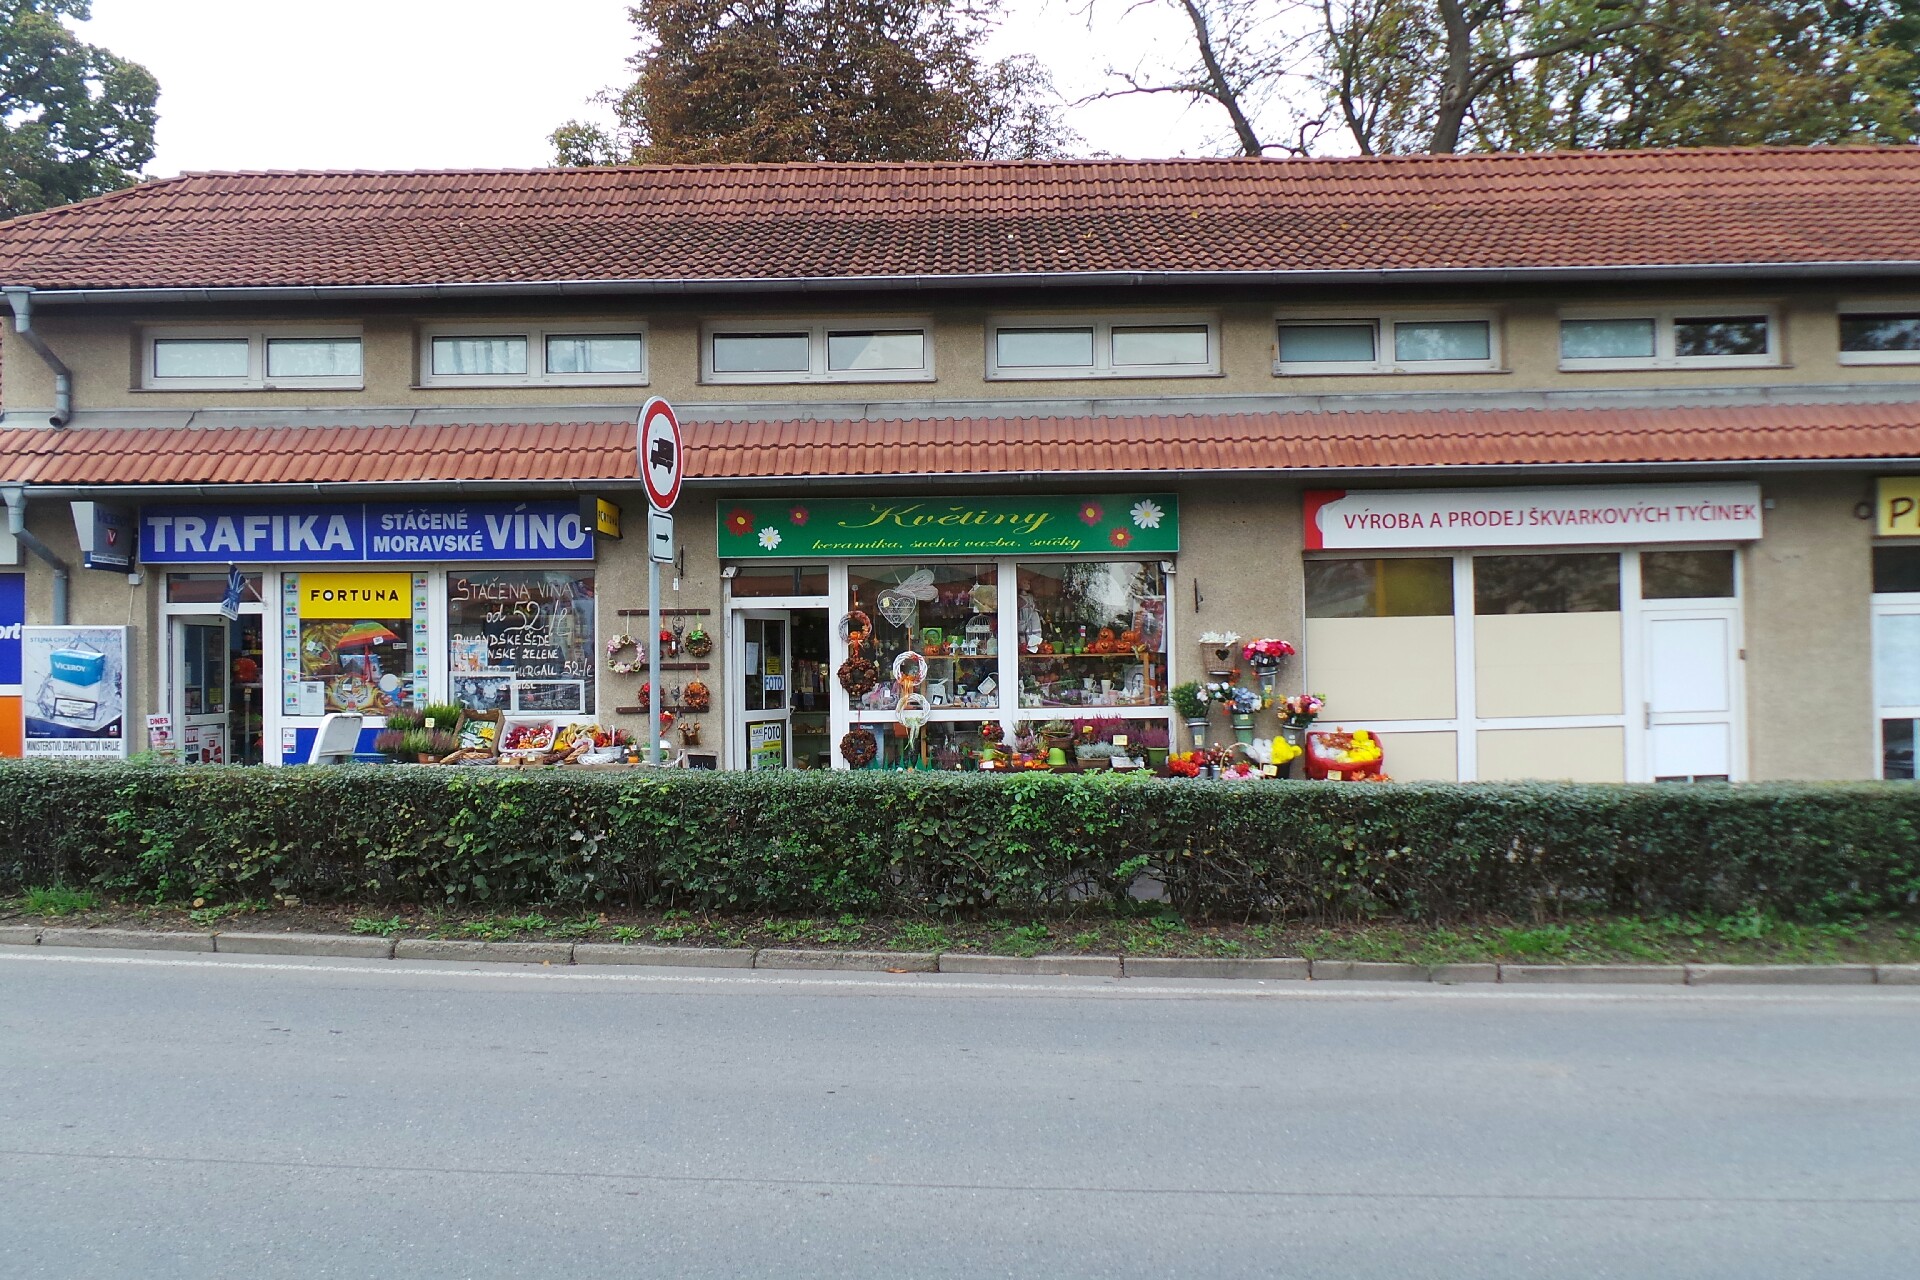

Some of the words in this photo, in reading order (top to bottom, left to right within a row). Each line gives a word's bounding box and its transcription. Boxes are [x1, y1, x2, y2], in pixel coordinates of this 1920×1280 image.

[381, 508, 468, 530] STÁČENÉ
[837, 503, 1055, 535] Květiny
[1344, 508, 1424, 530] VÝROBA
[1430, 512, 1443, 528] A
[1449, 510, 1524, 527] PRODEJ
[1529, 501, 1670, 526] ŠKVARKOVÝCH
[1674, 500, 1757, 522] TYČINEK
[1888, 497, 1920, 528] P
[147, 515, 355, 553] TRAFIKA
[485, 503, 586, 550] VÍNO
[373, 530, 483, 553] MORAVSKÉ
[910, 538, 960, 549] suchá
[1029, 536, 1081, 551] svíčky
[311, 589, 399, 602] FORTUNA
[486, 603, 507, 624] od
[54, 661, 86, 672] VICEROY
[764, 676, 784, 691] FOTO
[150, 717, 169, 726] DNES
[763, 725, 781, 741] FOTO
[26, 740, 61, 752] MINISTERSTVO
